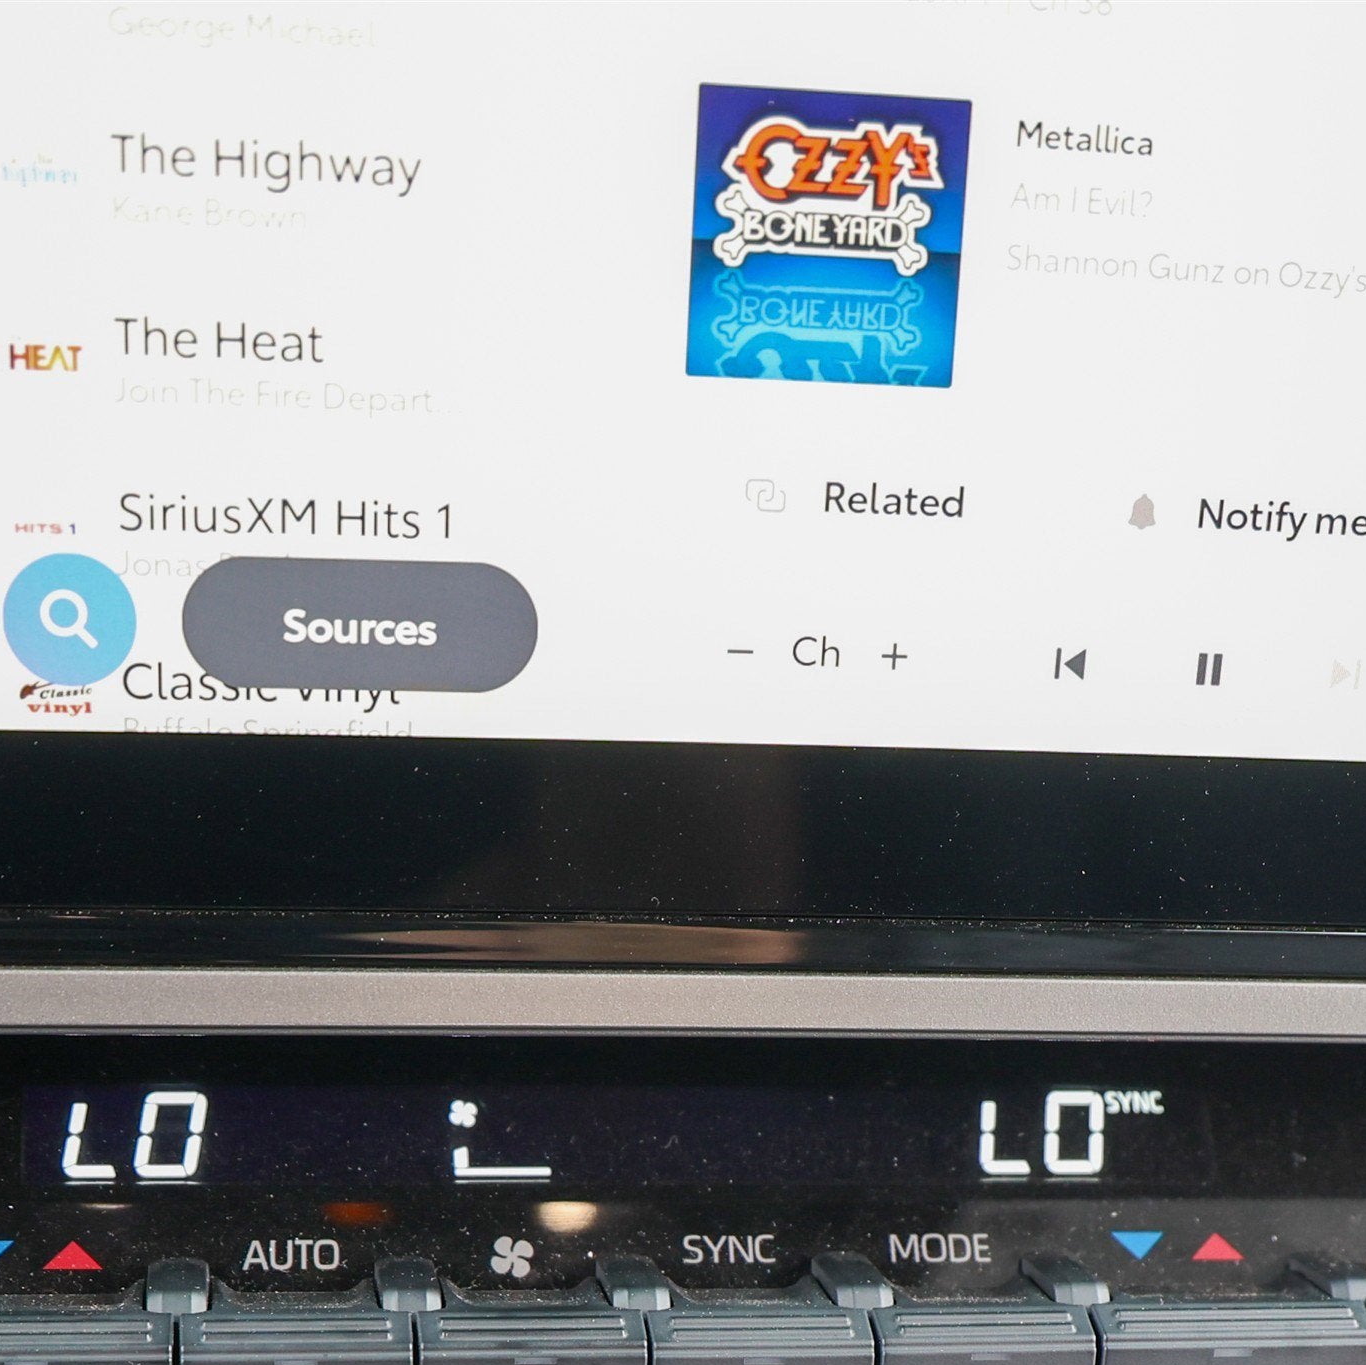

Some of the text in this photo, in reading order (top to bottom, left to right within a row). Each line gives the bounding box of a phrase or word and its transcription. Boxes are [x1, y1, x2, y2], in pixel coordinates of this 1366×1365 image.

[108, 6, 377, 47] George Michael
[1016, 120, 1154, 156] Metallica
[110, 132, 422, 197] The Highway
[112, 196, 308, 228] Kane Brown
[1011, 183, 1152, 218] Am I Evil?
[1006, 244, 1136, 279] Shannon
[1149, 254, 1225, 284] Gunz
[1234, 263, 1270, 286] on
[115, 316, 325, 363] The Heat
[8, 342, 83, 372] HEAT
[115, 377, 178, 404] Join
[190, 378, 244, 405] The
[256, 380, 311, 408] Fire
[119, 492, 452, 539] SiriusXM Hits 1
[823, 482, 965, 521] Related
[15, 523, 76, 535] HITS 1
[1197, 499, 1308, 543] Notify
[118, 550, 205, 578] Jonas
[284, 609, 436, 645] Sources
[792, 635, 841, 669] Ch
[39, 684, 92, 700] Classic
[27, 701, 91, 717] vinyl
[1105, 1090, 1164, 1114] SYNC
[242, 1238, 341, 1271] AUTO
[682, 1234, 776, 1264] SYNC
[889, 1233, 991, 1263] MODE
